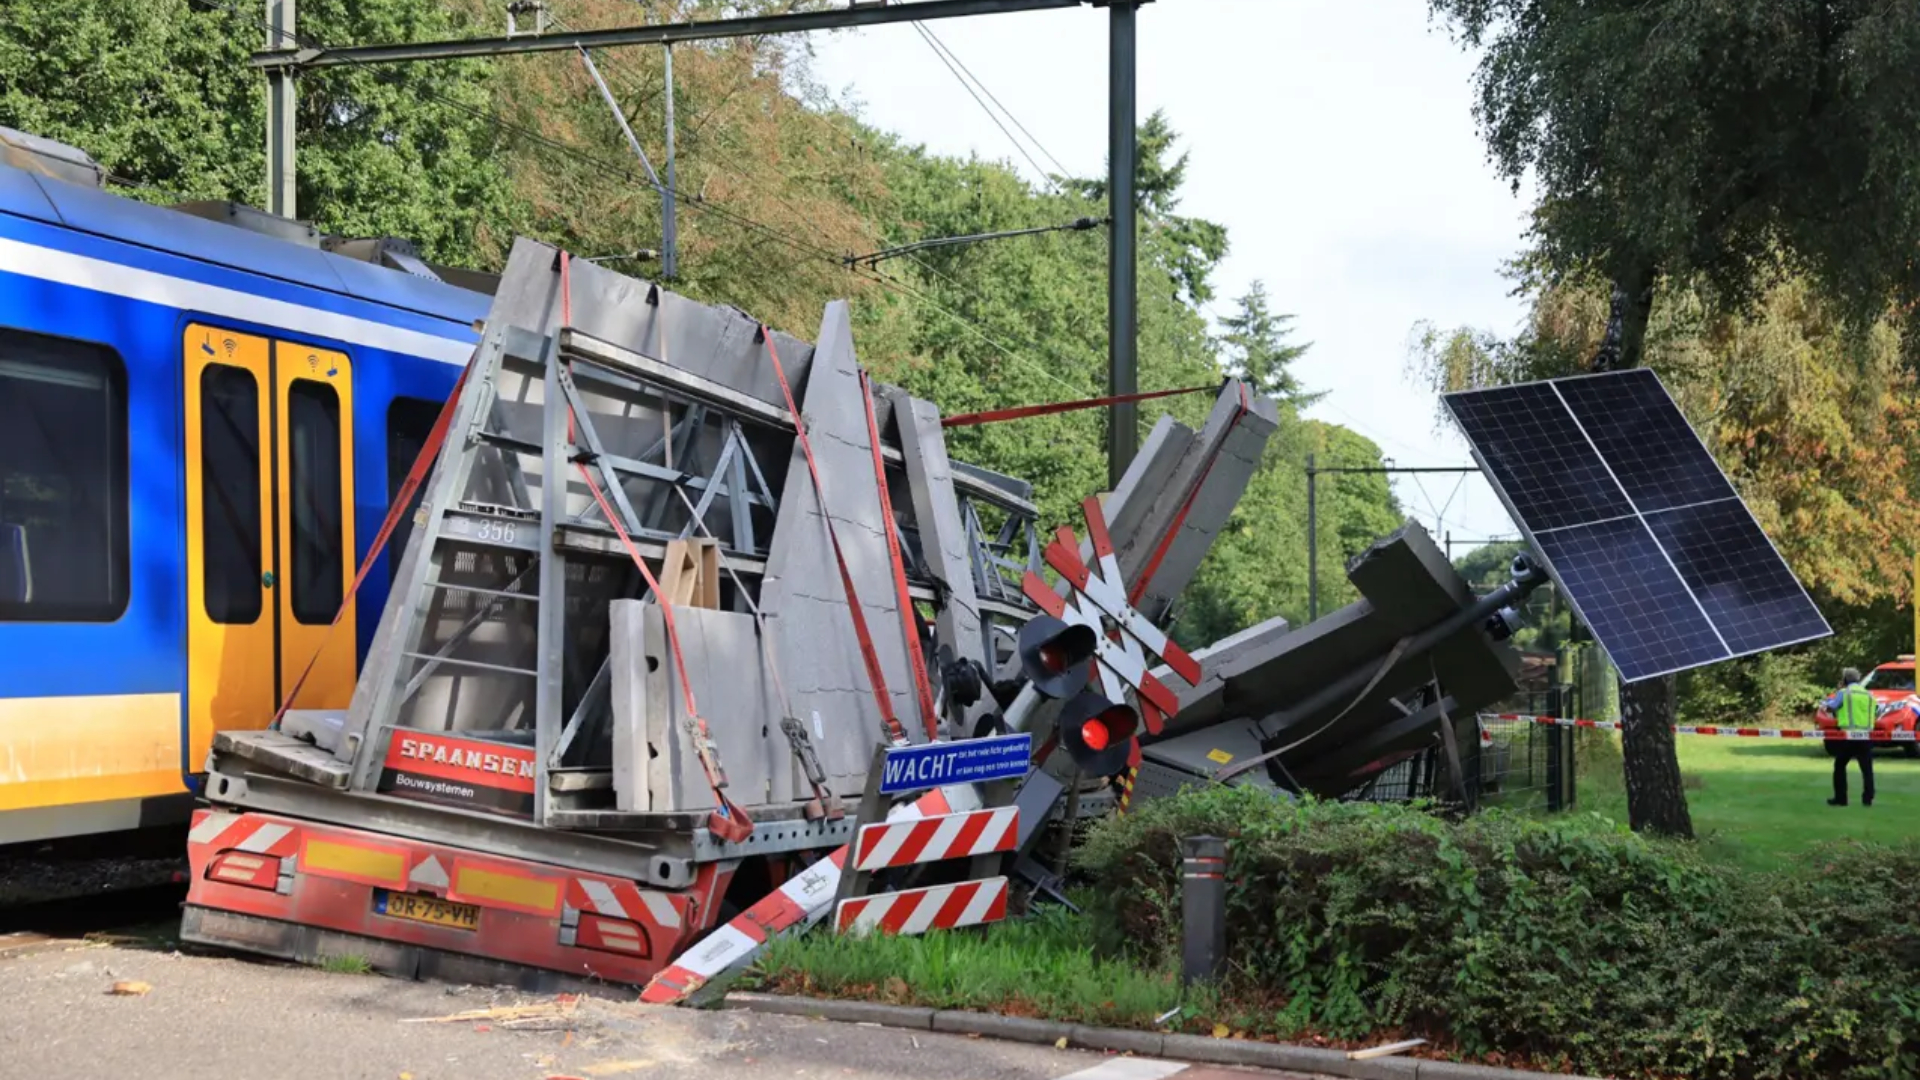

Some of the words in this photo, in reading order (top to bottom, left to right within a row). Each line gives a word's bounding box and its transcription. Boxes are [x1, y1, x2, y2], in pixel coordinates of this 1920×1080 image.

[478, 519, 516, 543] 356
[400, 738, 536, 780] SPAANSEN
[885, 753, 957, 784] WACHT
[396, 773, 474, 798] Bouwsystemen
[391, 895, 477, 926] OR-75-VH
